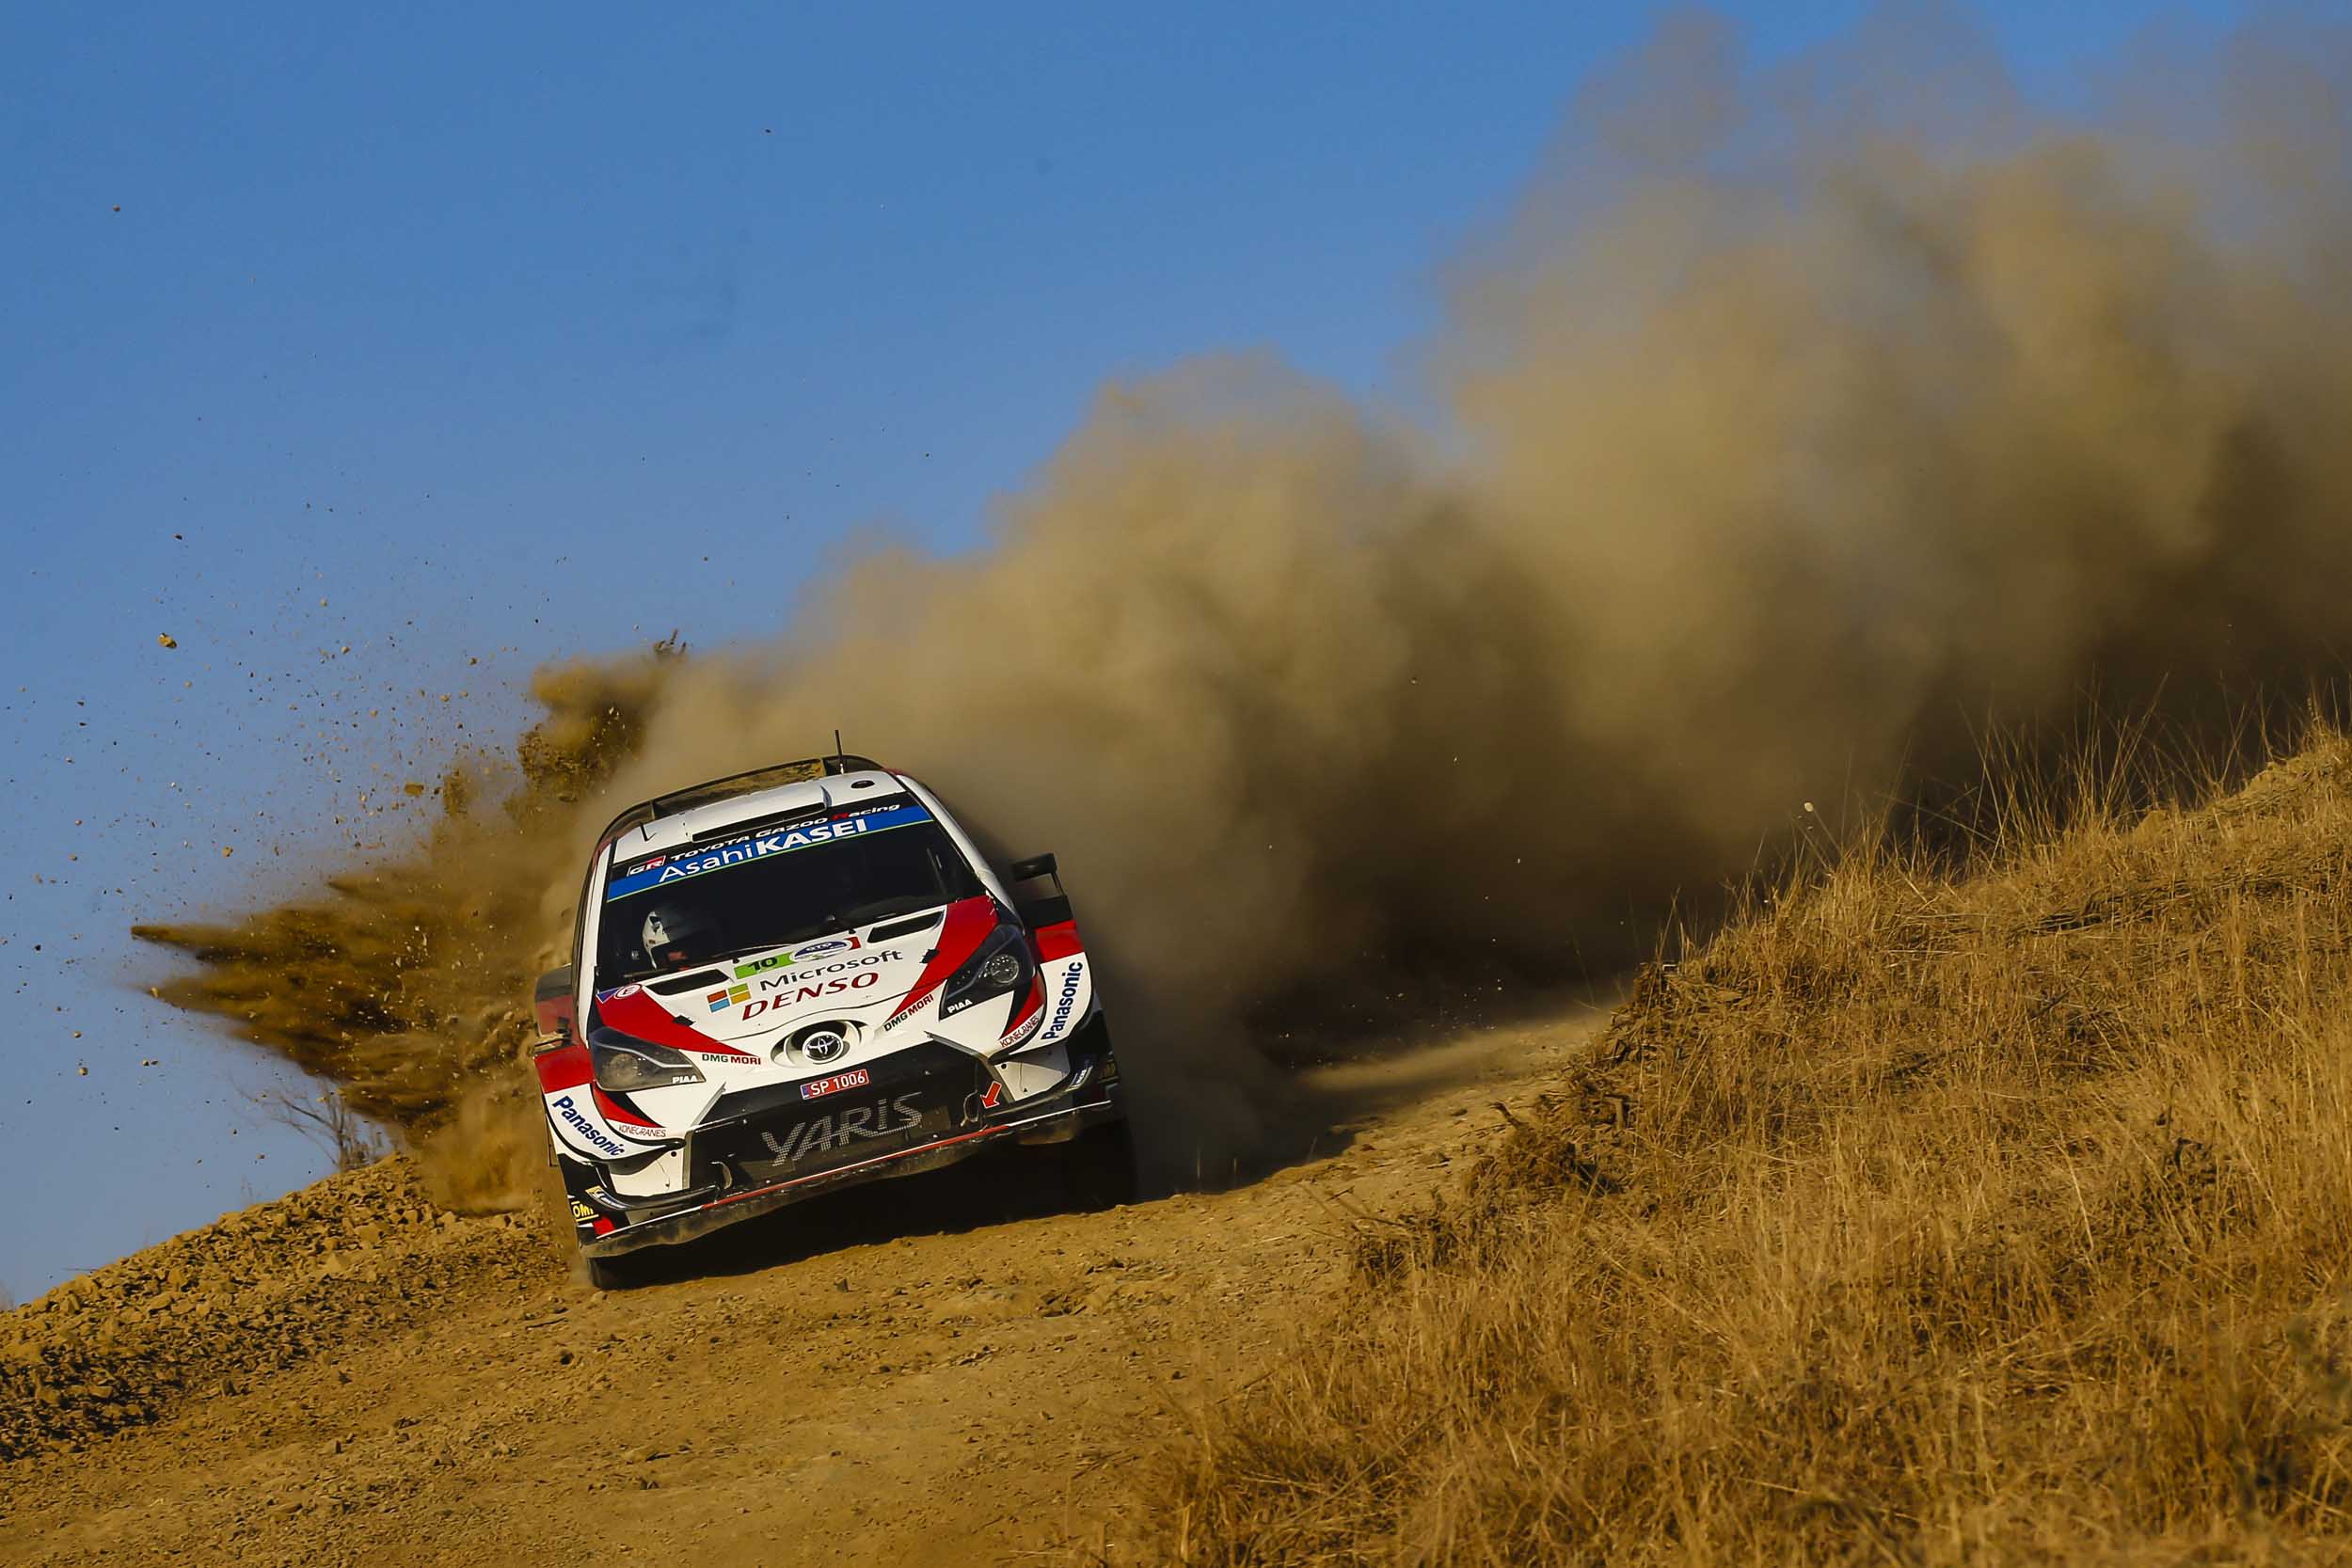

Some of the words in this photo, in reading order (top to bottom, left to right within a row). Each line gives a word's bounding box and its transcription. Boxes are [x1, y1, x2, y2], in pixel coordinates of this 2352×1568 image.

[671, 835, 750, 862] TOYOTA
[755, 816, 828, 838] GAZOO
[832, 803, 900, 821] Racing
[753, 956, 777, 972] 10
[759, 950, 903, 991] Microsoft
[741, 972, 880, 1022] DENSO
[883, 1012, 909, 1032] DMG
[907, 993, 934, 1016] MORI
[946, 998, 973, 1015] PIAA
[1041, 961, 1084, 1040] Panasonic
[702, 1053, 728, 1063] DMG
[730, 1055, 761, 1065] MORI
[672, 1074, 698, 1084] PIAA
[810, 1081, 831, 1097] SP
[833, 1071, 866, 1091] 1006
[551, 1095, 626, 1157] Panasonic
